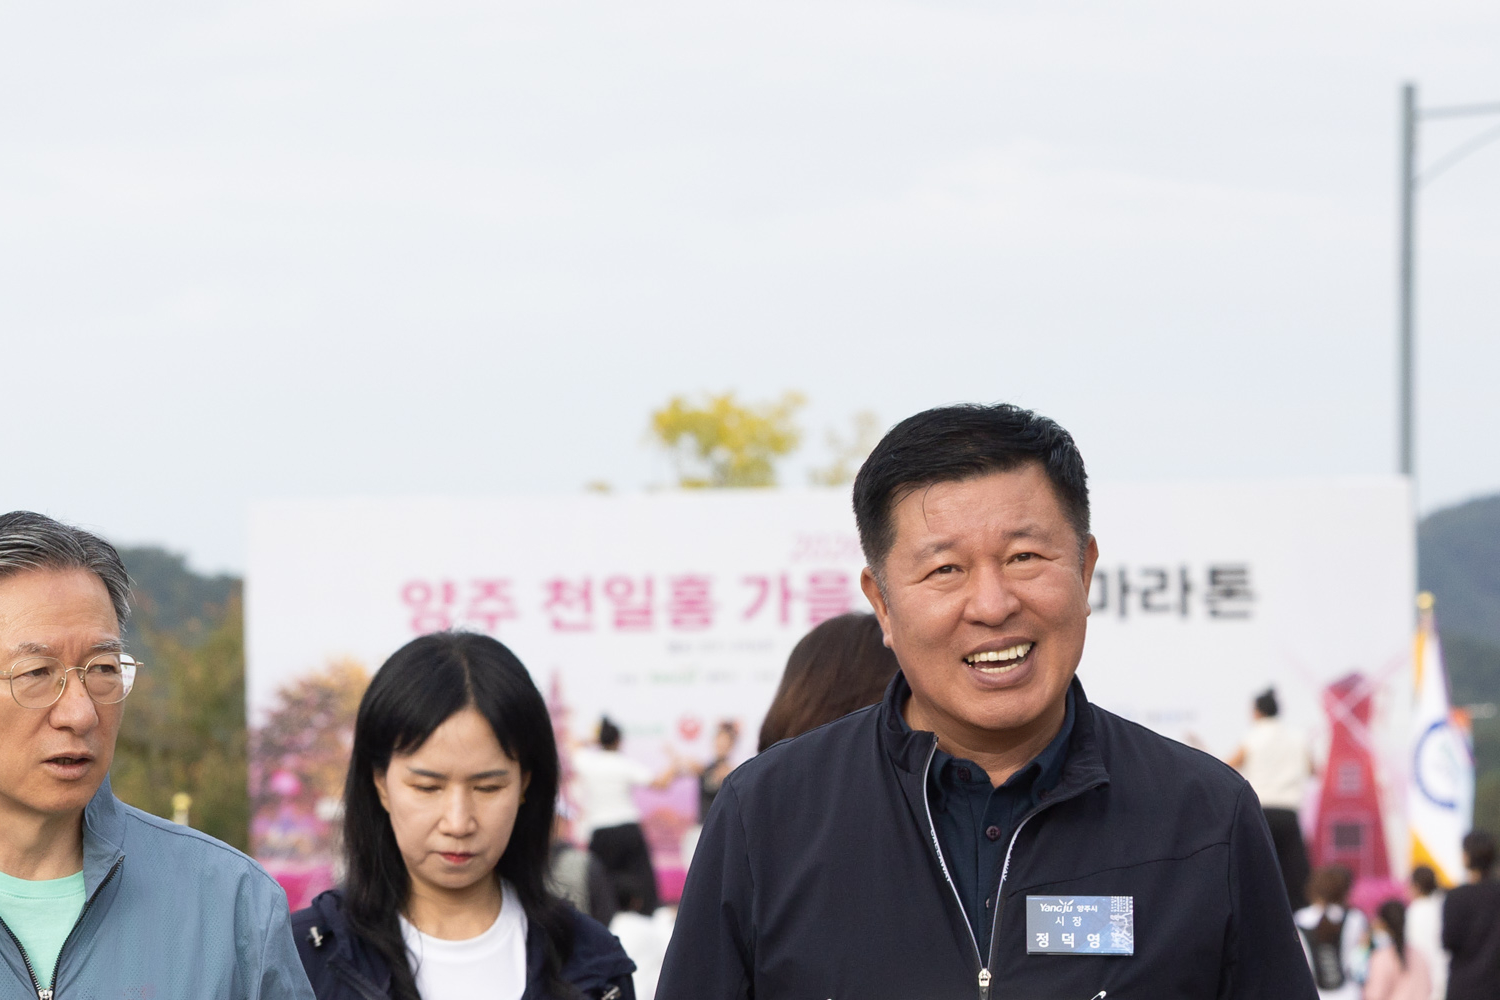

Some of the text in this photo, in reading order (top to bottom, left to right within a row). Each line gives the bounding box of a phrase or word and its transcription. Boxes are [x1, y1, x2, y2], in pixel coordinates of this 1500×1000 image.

[400, 577, 519, 632] 양주
[543, 575, 721, 632] 천일홍
[740, 570, 855, 630] 가을
[1076, 904, 1098, 913] 양주시
[1055, 916, 1083, 927] 시장
[1035, 932, 1101, 949] 정덕영
